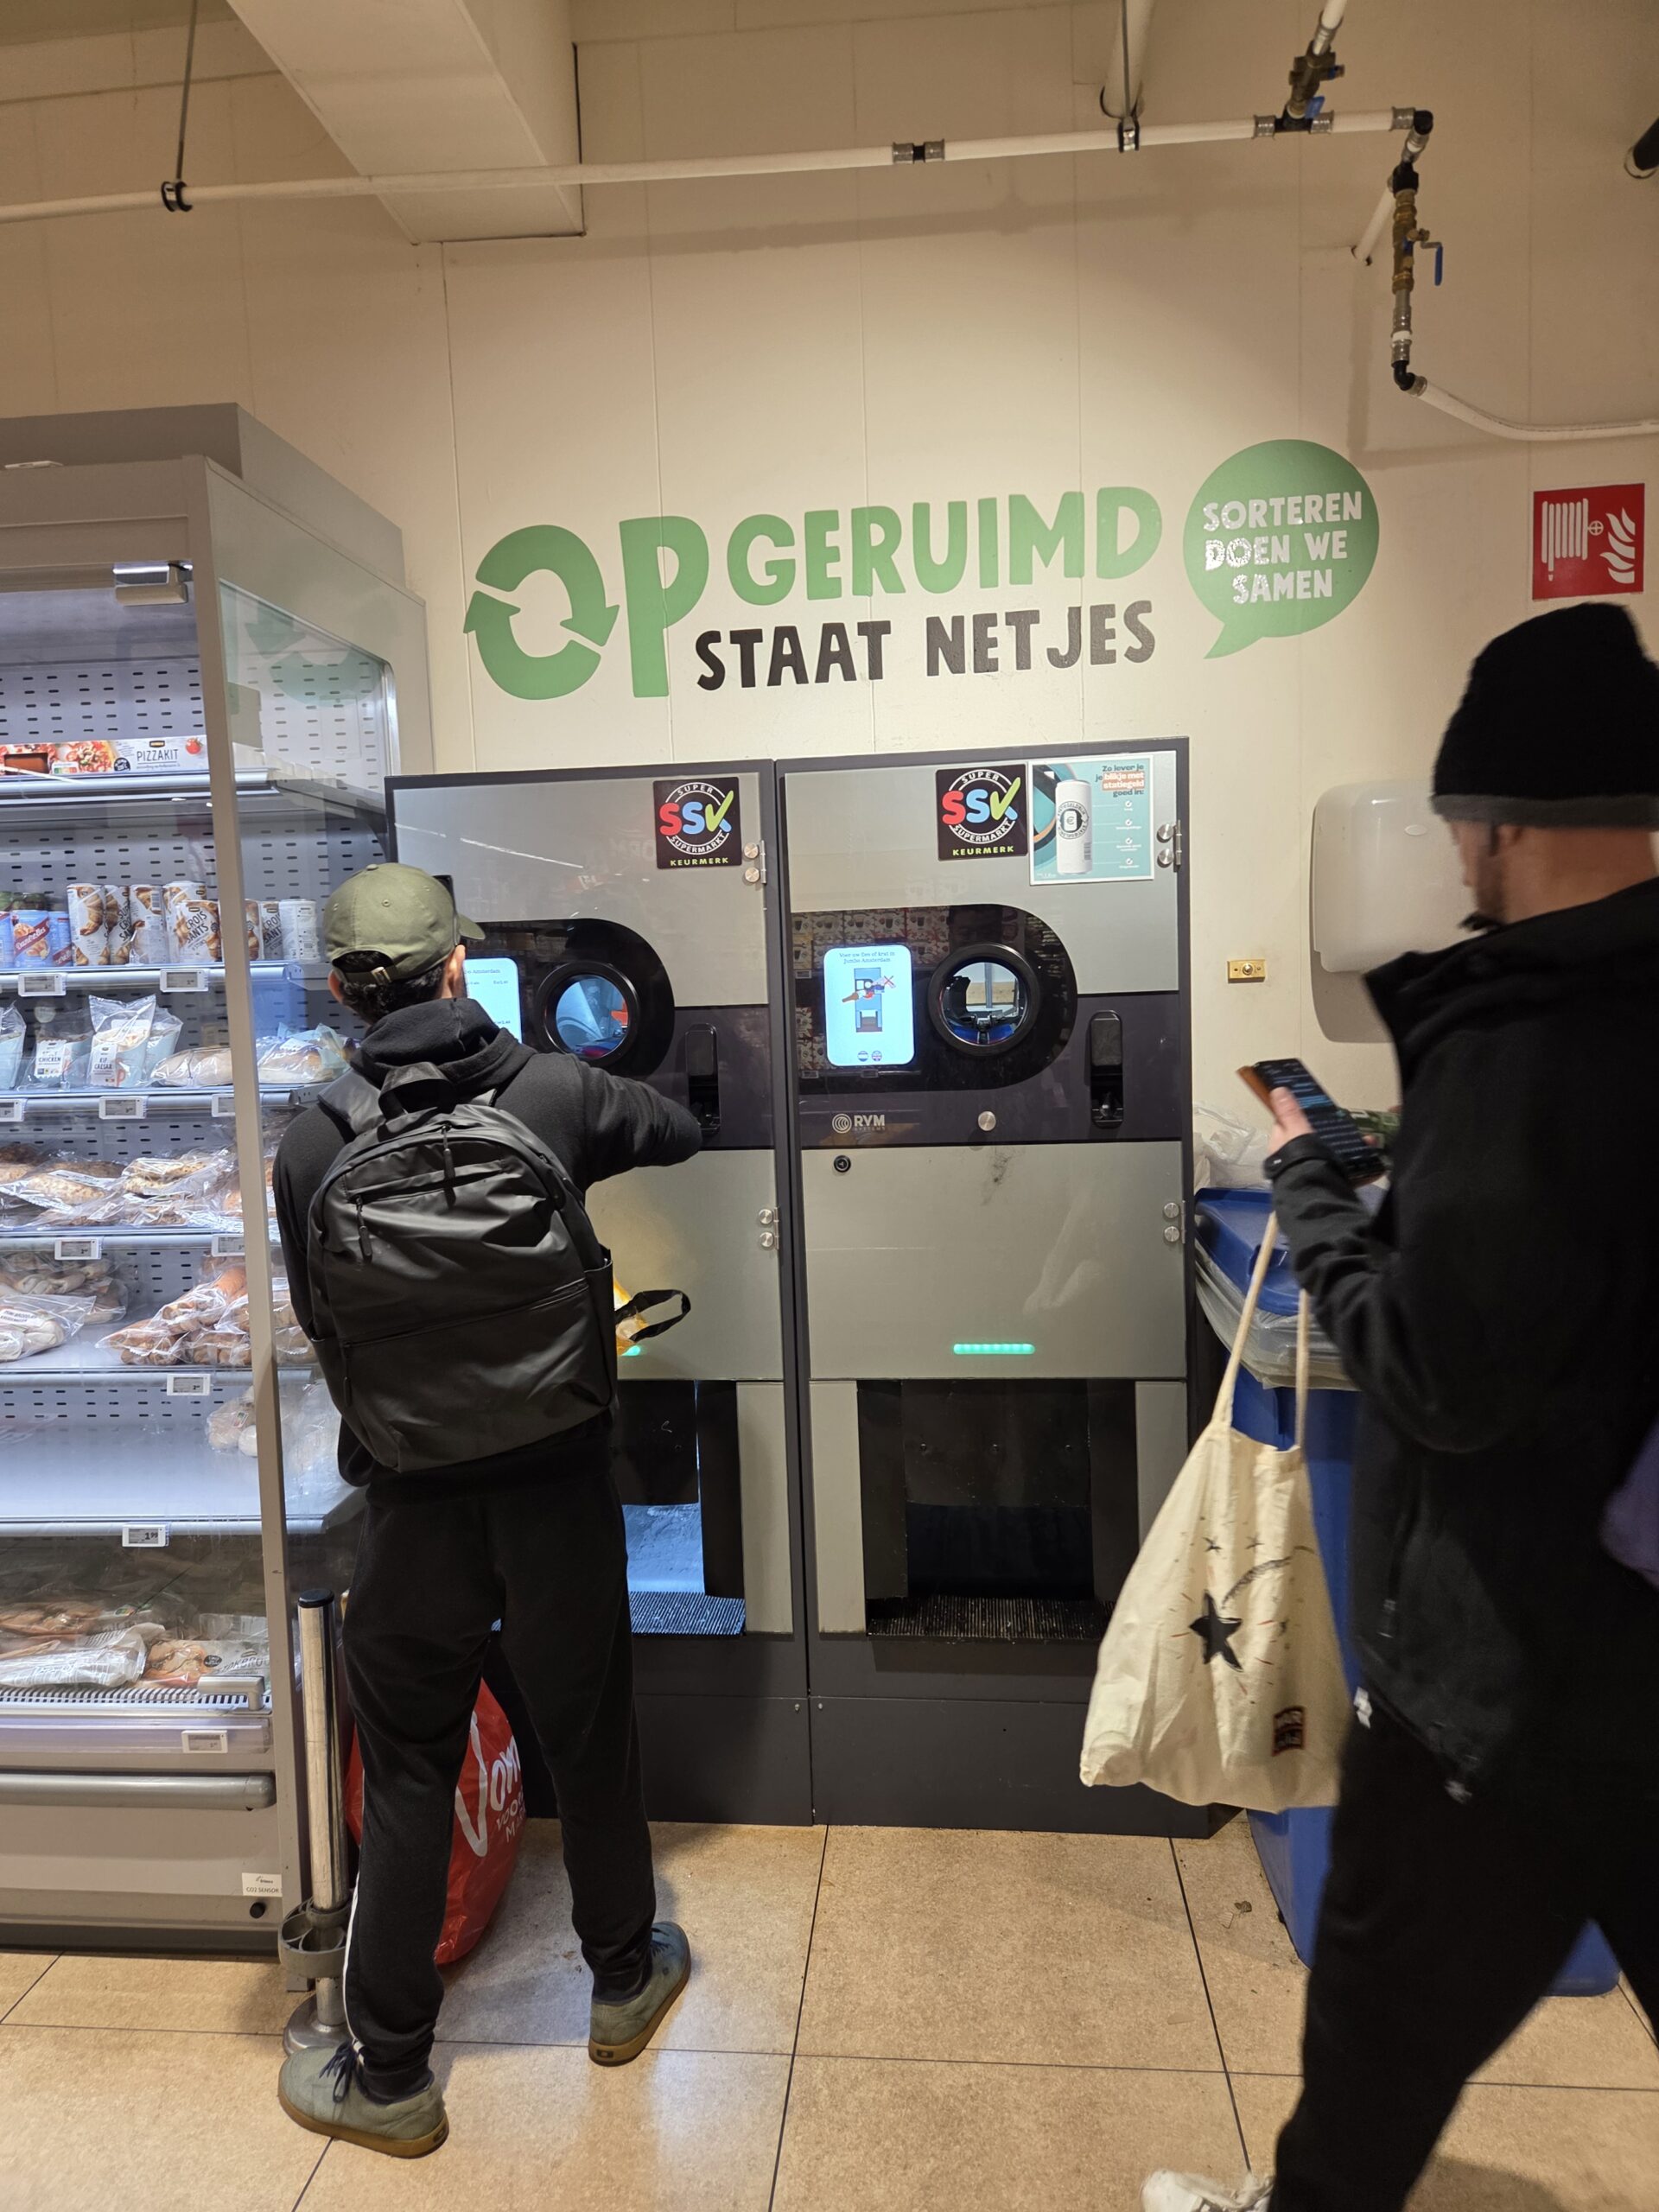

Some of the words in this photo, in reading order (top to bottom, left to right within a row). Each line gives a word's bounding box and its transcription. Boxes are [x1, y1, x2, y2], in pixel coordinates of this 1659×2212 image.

[1203, 491, 1362, 531] SORTEREN
[1205, 537, 1290, 571] DOEN
[1304, 530, 1348, 560] WE
[1233, 569, 1333, 604] SAMEN
[695, 620, 891, 691] STAAT
[926, 601, 1155, 677] NETJES
[137, 748, 179, 761] PIZZAKIT
[962, 772, 1000, 784] SUPER
[677, 784, 714, 795] SUPER
[953, 821, 1011, 842] SUPERMARKT
[671, 832, 726, 853] SUPERMARKT
[952, 846, 1014, 855] KEURMERK
[671, 857, 729, 866] KEURMERK
[854, 1115, 885, 1127] RVM
